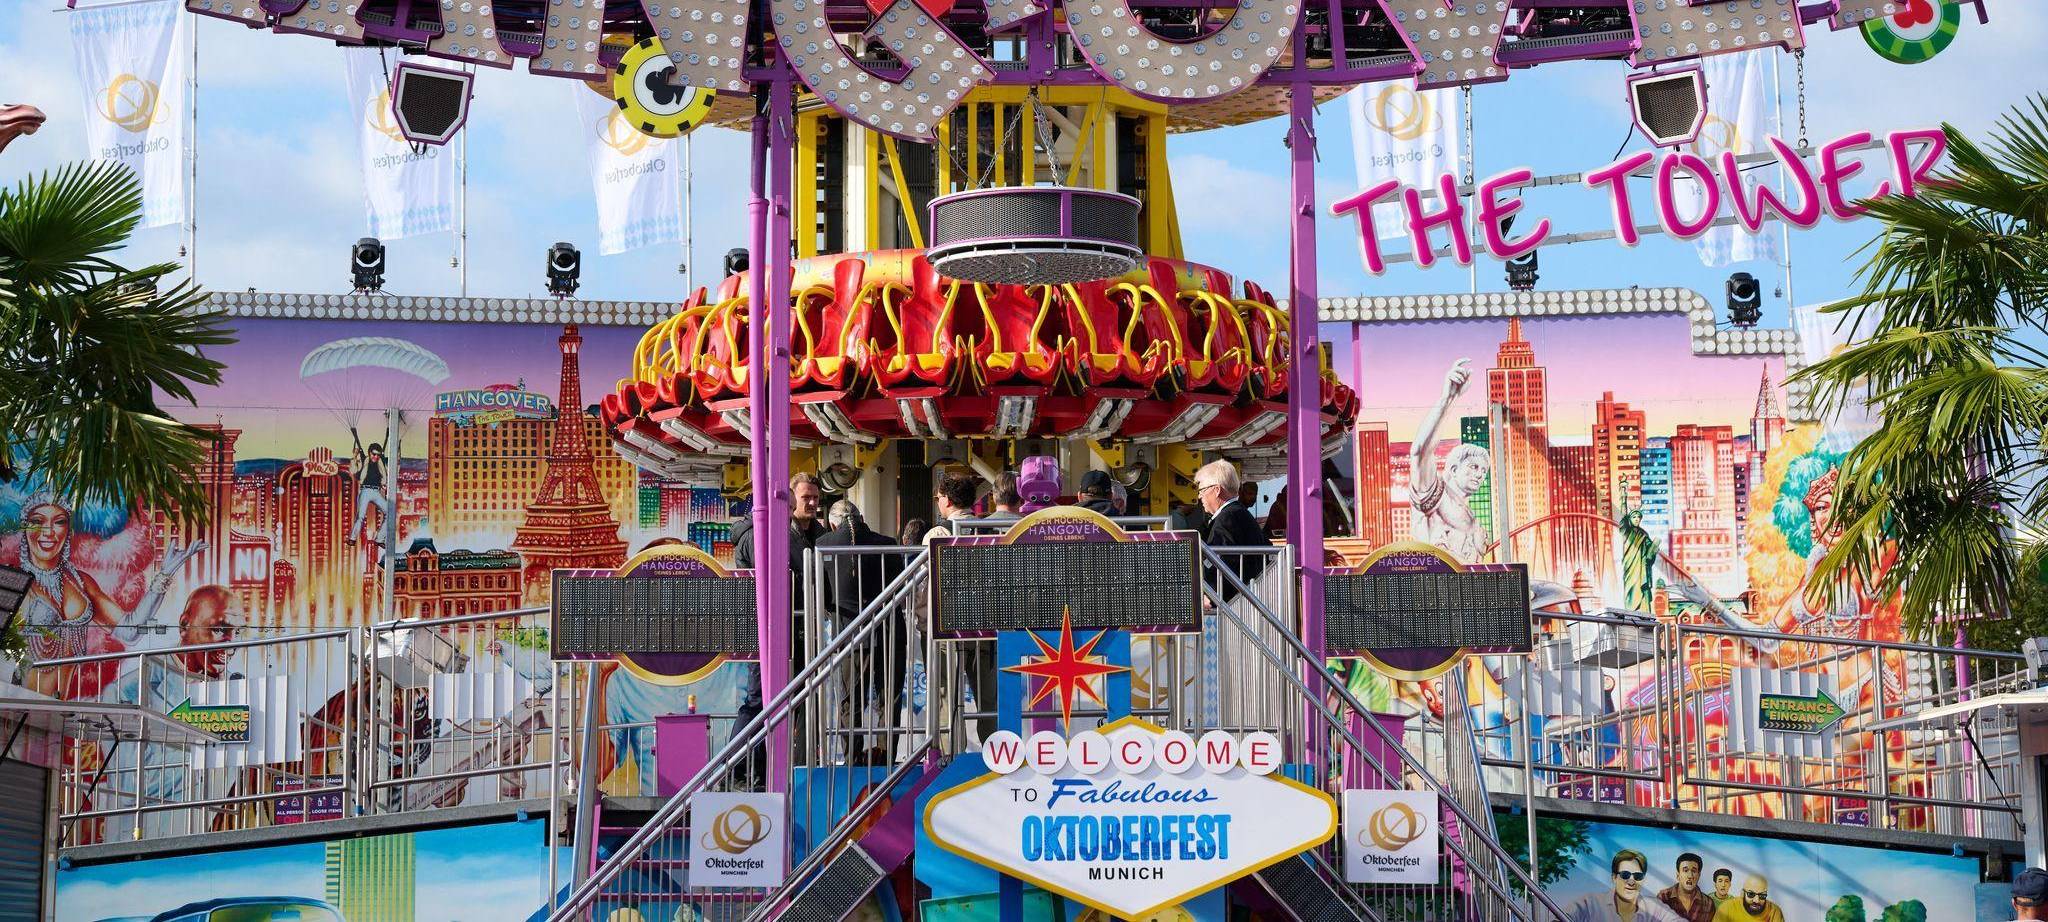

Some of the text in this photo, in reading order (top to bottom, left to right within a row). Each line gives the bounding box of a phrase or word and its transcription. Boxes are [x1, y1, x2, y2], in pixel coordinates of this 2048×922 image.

[1330, 128, 1962, 275] THE TOWER
[438, 391, 548, 411] HANGOVER
[1029, 524, 1100, 535] HANGOVER
[234, 547, 267, 581] NO
[641, 561, 705, 570] HANGOVER
[1379, 557, 1441, 567] HANGOVER
[1760, 698, 1834, 715] ENTRANCE
[172, 711, 249, 723] ENTRANCE
[1769, 710, 1825, 724] EINGANG
[988, 740, 1270, 766] WELCOME
[1010, 777, 1218, 810] TO Fabulous
[1021, 813, 1232, 862] OKTOBERFEST
[705, 857, 764, 870] Oktoberfest
[1362, 853, 1420, 867] Oktoberfest
[1088, 867, 1165, 881] MUNICH
